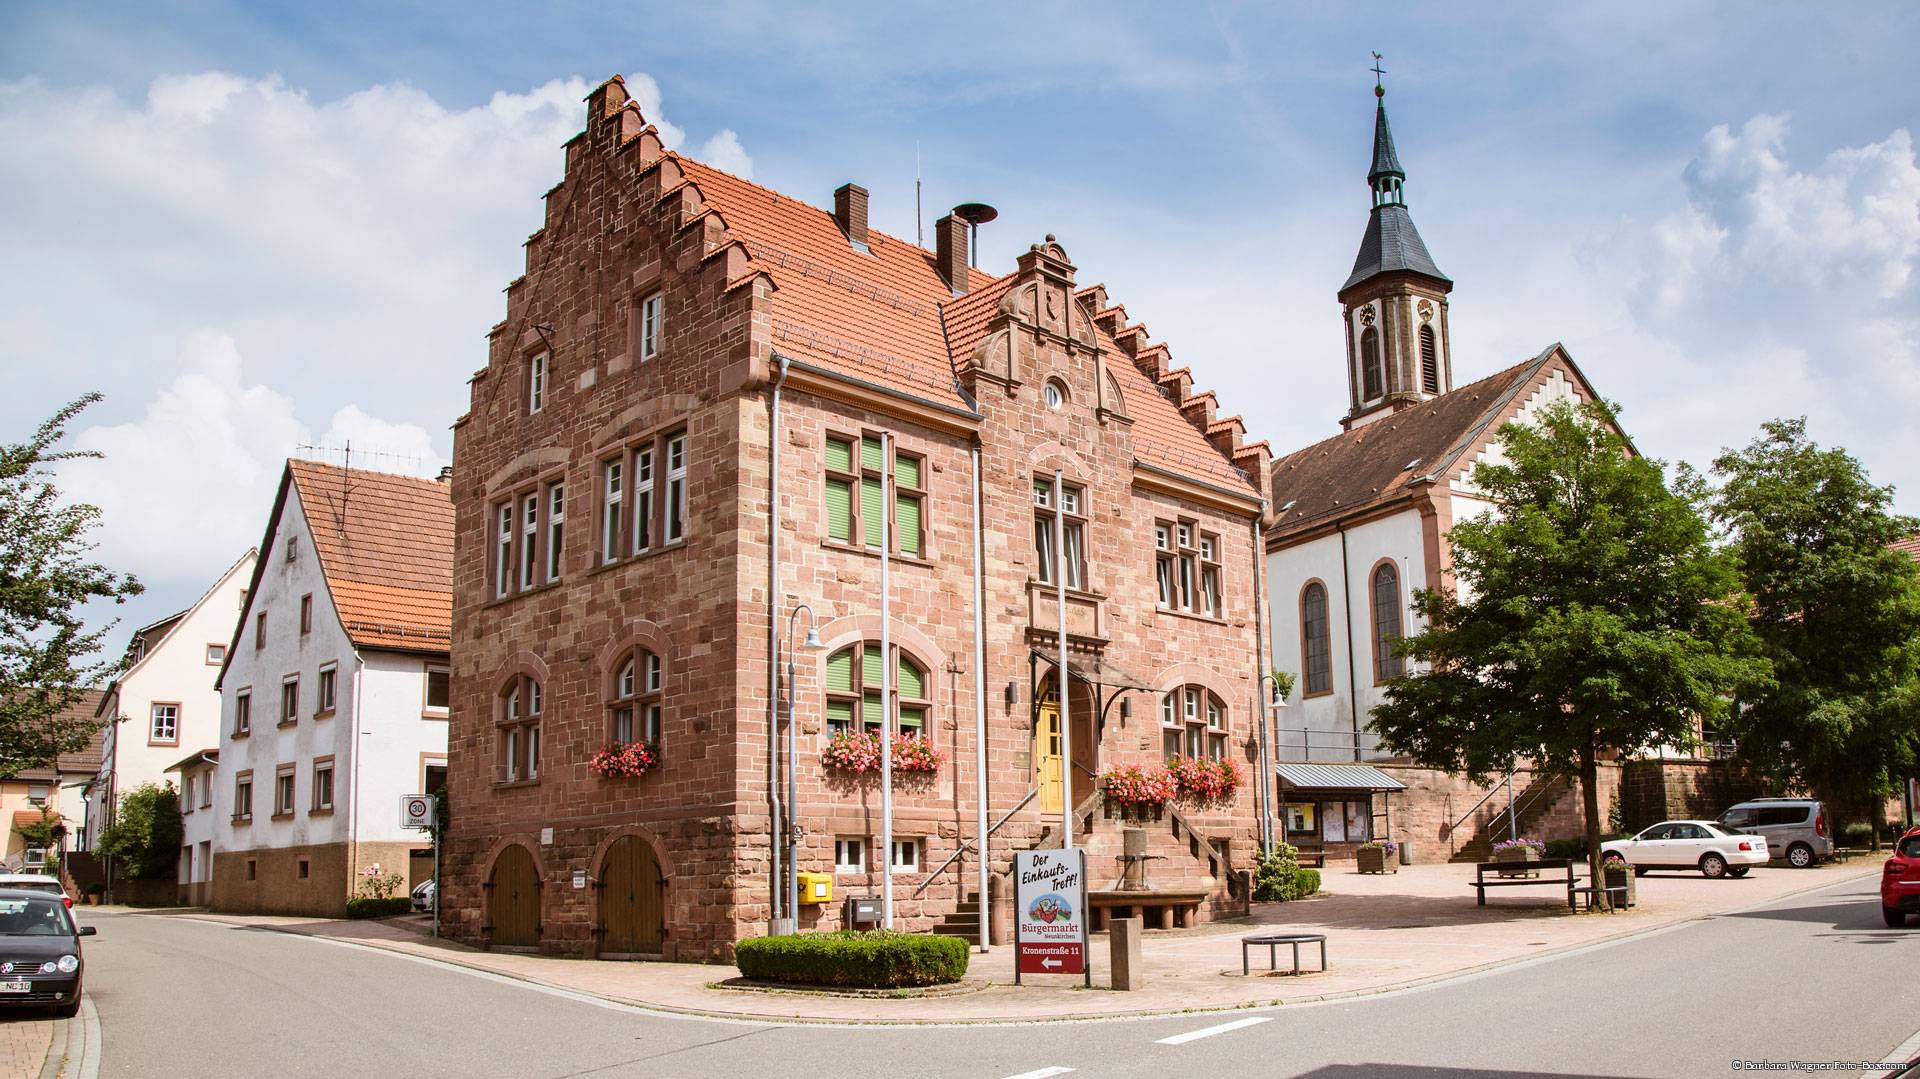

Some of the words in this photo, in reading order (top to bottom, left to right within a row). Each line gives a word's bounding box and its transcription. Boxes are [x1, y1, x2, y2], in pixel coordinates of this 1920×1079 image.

[412, 804, 423, 813] 30
[1032, 854, 1049, 867] Der
[1022, 863, 1069, 885] Einkaufs-
[1052, 873, 1078, 891] Treff!
[1022, 923, 1078, 935] Bürgermarkt
[1022, 946, 1069, 955] Kronenstraße
[1071, 947, 1079, 955] 11
